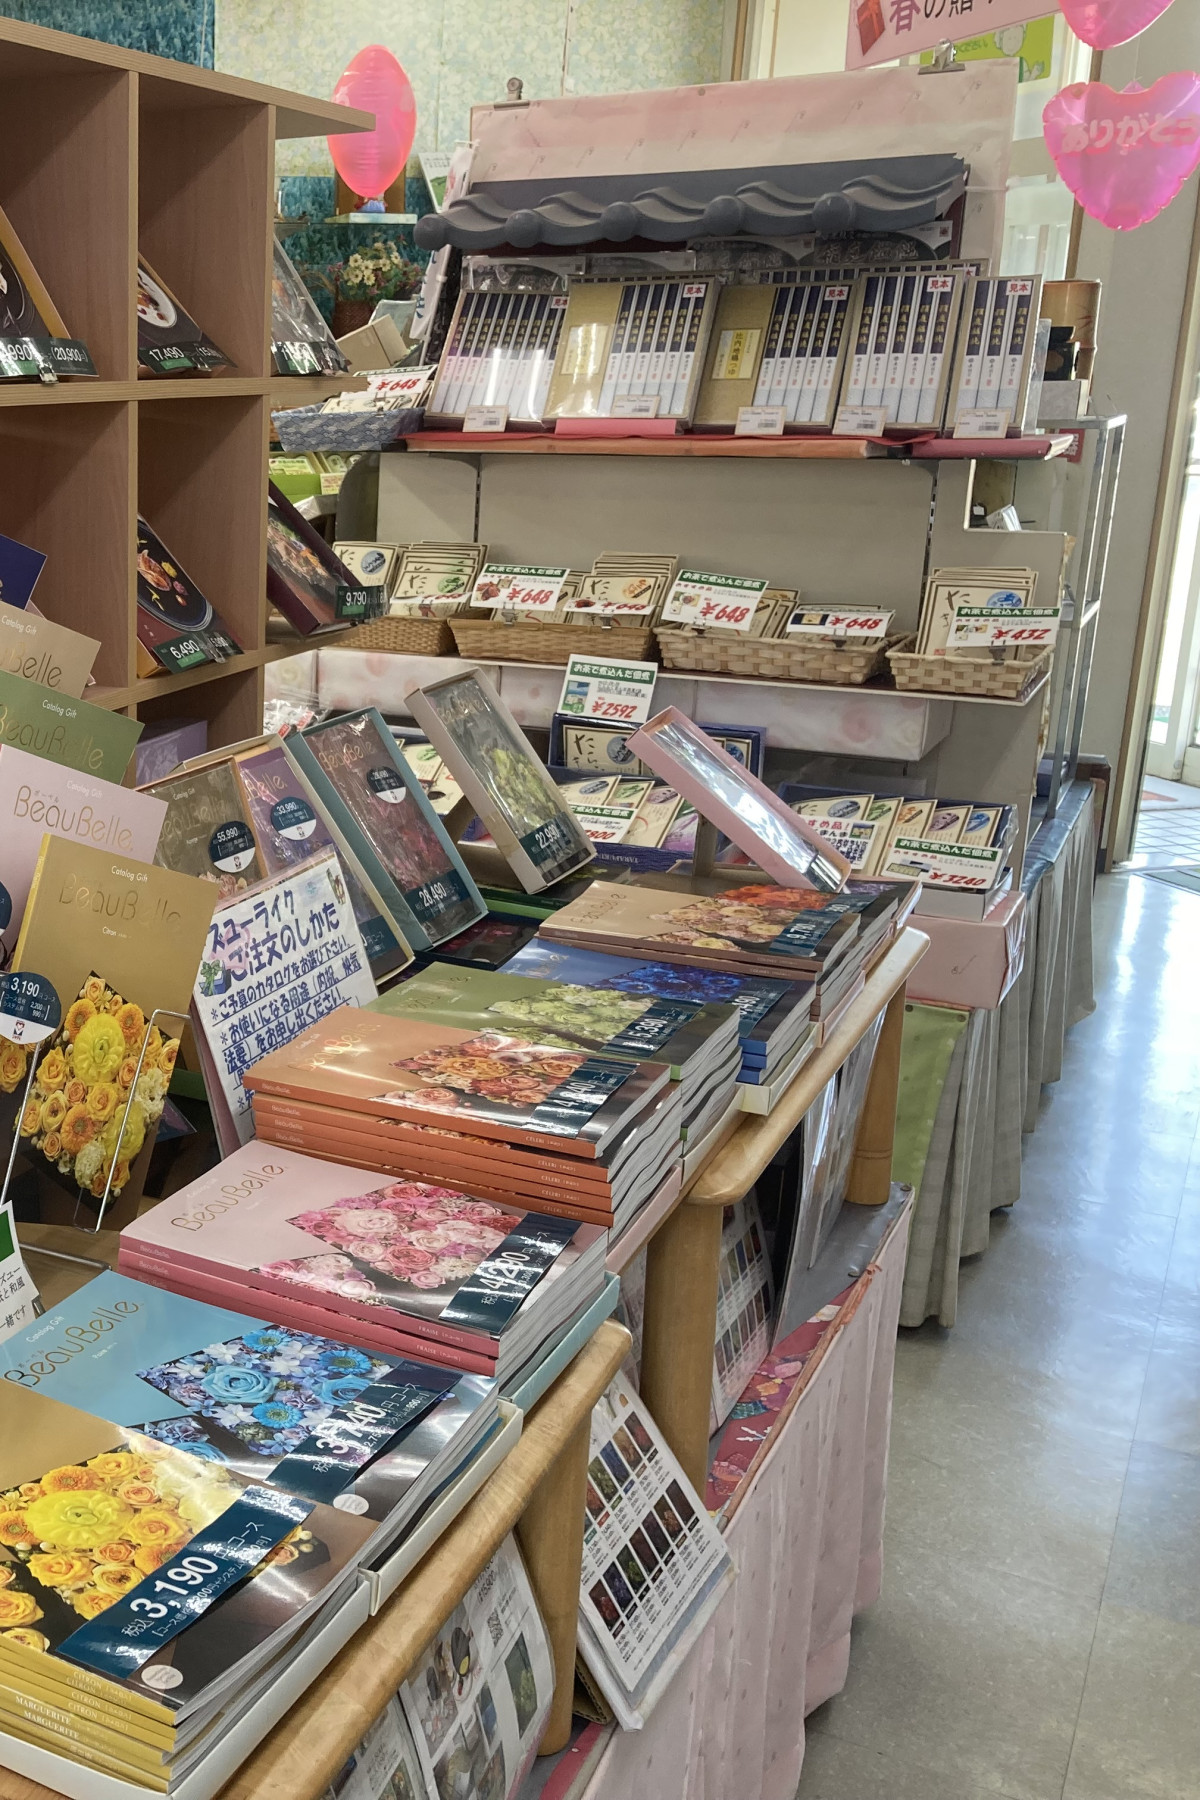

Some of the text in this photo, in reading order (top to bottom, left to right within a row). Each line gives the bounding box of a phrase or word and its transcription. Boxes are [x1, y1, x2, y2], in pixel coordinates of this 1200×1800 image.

[826, 287, 846, 300] 見本
[930, 278, 951, 291] 見本
[1008, 281, 1030, 294] 見本
[147, 345, 185, 362] 17,490
[345, 591, 367, 606] 9,790
[506, 587, 554, 605] ¥648
[700, 601, 750, 623] ¥648
[1, 614, 37, 636] Catalog Gift
[828, 616, 883, 630] ¥648
[991, 627, 1051, 642] ¥432
[170, 639, 200, 659] 6,490
[573, 662, 651, 681] お茶で煮込んだ佃煮
[42, 699, 78, 720] Catalog Gift
[591, 701, 638, 719] ¥2592
[13, 785, 134, 850] BeauBelle
[215, 826, 240, 843] 55,990
[111, 865, 149, 884] Catalog Gift
[929, 872, 988, 887] ¥3240
[418, 881, 448, 909] 28,490
[102, 925, 118, 937] Citron
[229, 902, 340, 982] ご注文のしかた
[10, 977, 40, 998] 3,190
[171, 1164, 284, 1232] BeauBelle
[25, 1315, 65, 1344] Catalog Gift
[3, 1298, 141, 1388] BeauBelle
[129, 1556, 219, 1621] 3,190
[73, 1671, 102, 1690] CITRON
[71, 1691, 101, 1709] CITRON
[15, 1695, 72, 1725] MARGUERITE
[68, 1701, 98, 1719] CITRON
[23, 1710, 80, 1740] MARGUERITE
